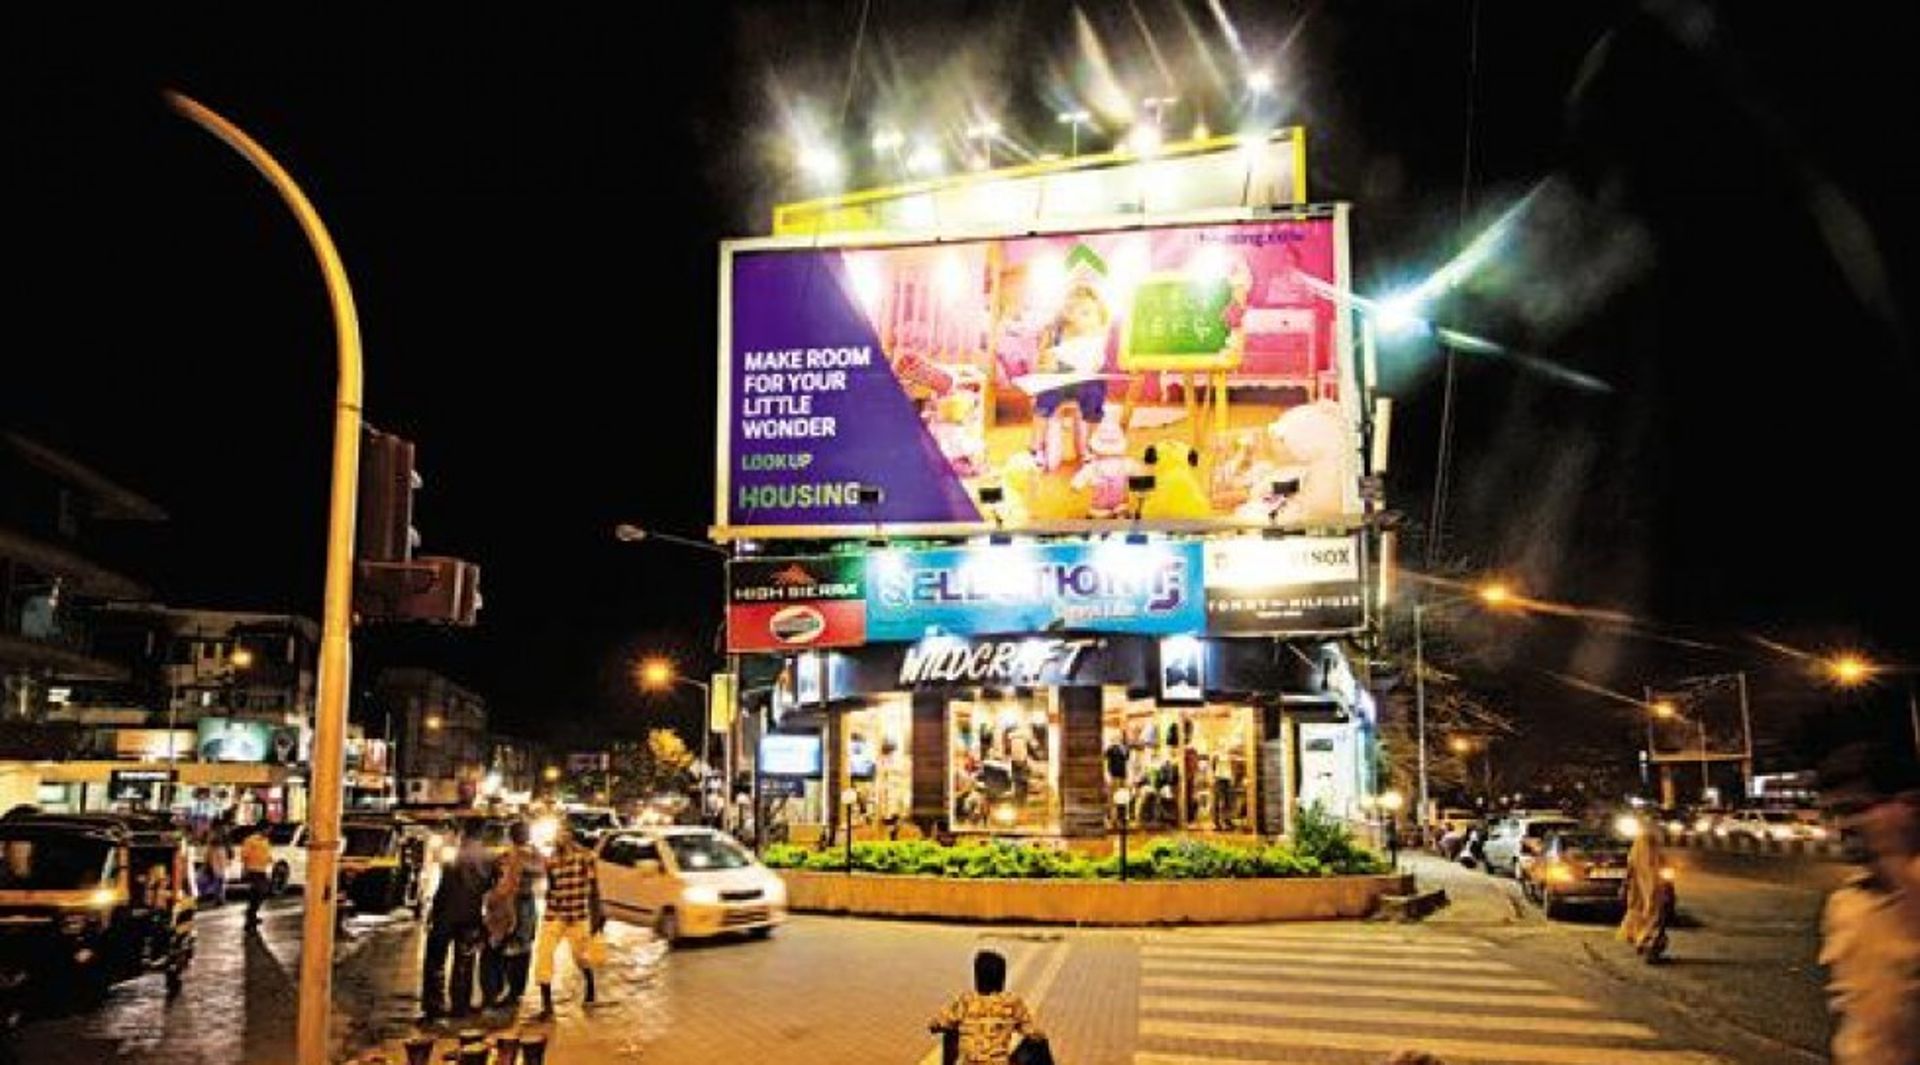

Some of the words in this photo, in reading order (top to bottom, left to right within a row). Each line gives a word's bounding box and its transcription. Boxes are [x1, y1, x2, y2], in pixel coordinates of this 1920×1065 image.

[744, 351, 803, 370] MAKE
[807, 347, 871, 368] ROOM
[744, 373, 784, 393] FOR
[788, 372, 846, 391] YOUR
[743, 395, 813, 417] LITTLE
[742, 417, 837, 439] WONDER
[741, 454, 787, 471] LOOK
[788, 453, 814, 470] UP
[740, 482, 860, 508] HOUSING
[735, 587, 783, 600] HIGH
